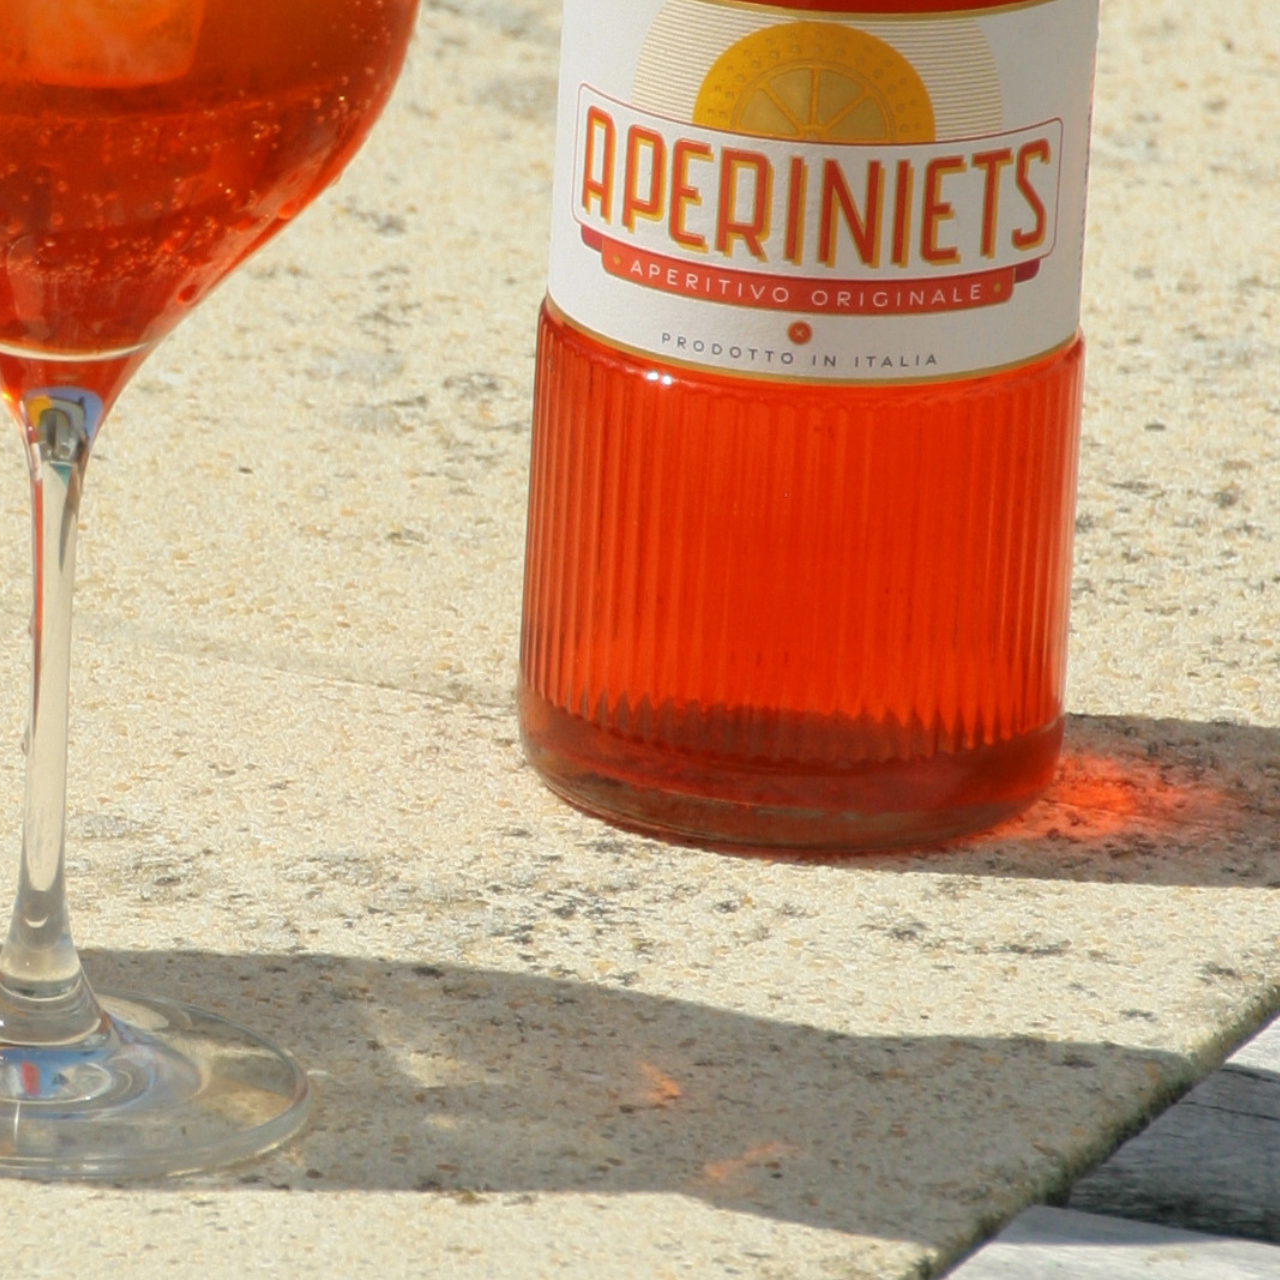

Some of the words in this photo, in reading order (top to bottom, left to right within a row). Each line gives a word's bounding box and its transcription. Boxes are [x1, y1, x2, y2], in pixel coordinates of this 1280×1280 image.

[580, 105, 1052, 269] APERINIETS
[629, 258, 791, 305] APERITIVO
[811, 282, 983, 308] ORIGINALE
[661, 331, 795, 366] PRODOTTO
[812, 353, 837, 368] IN
[854, 353, 939, 368] ITALIA
